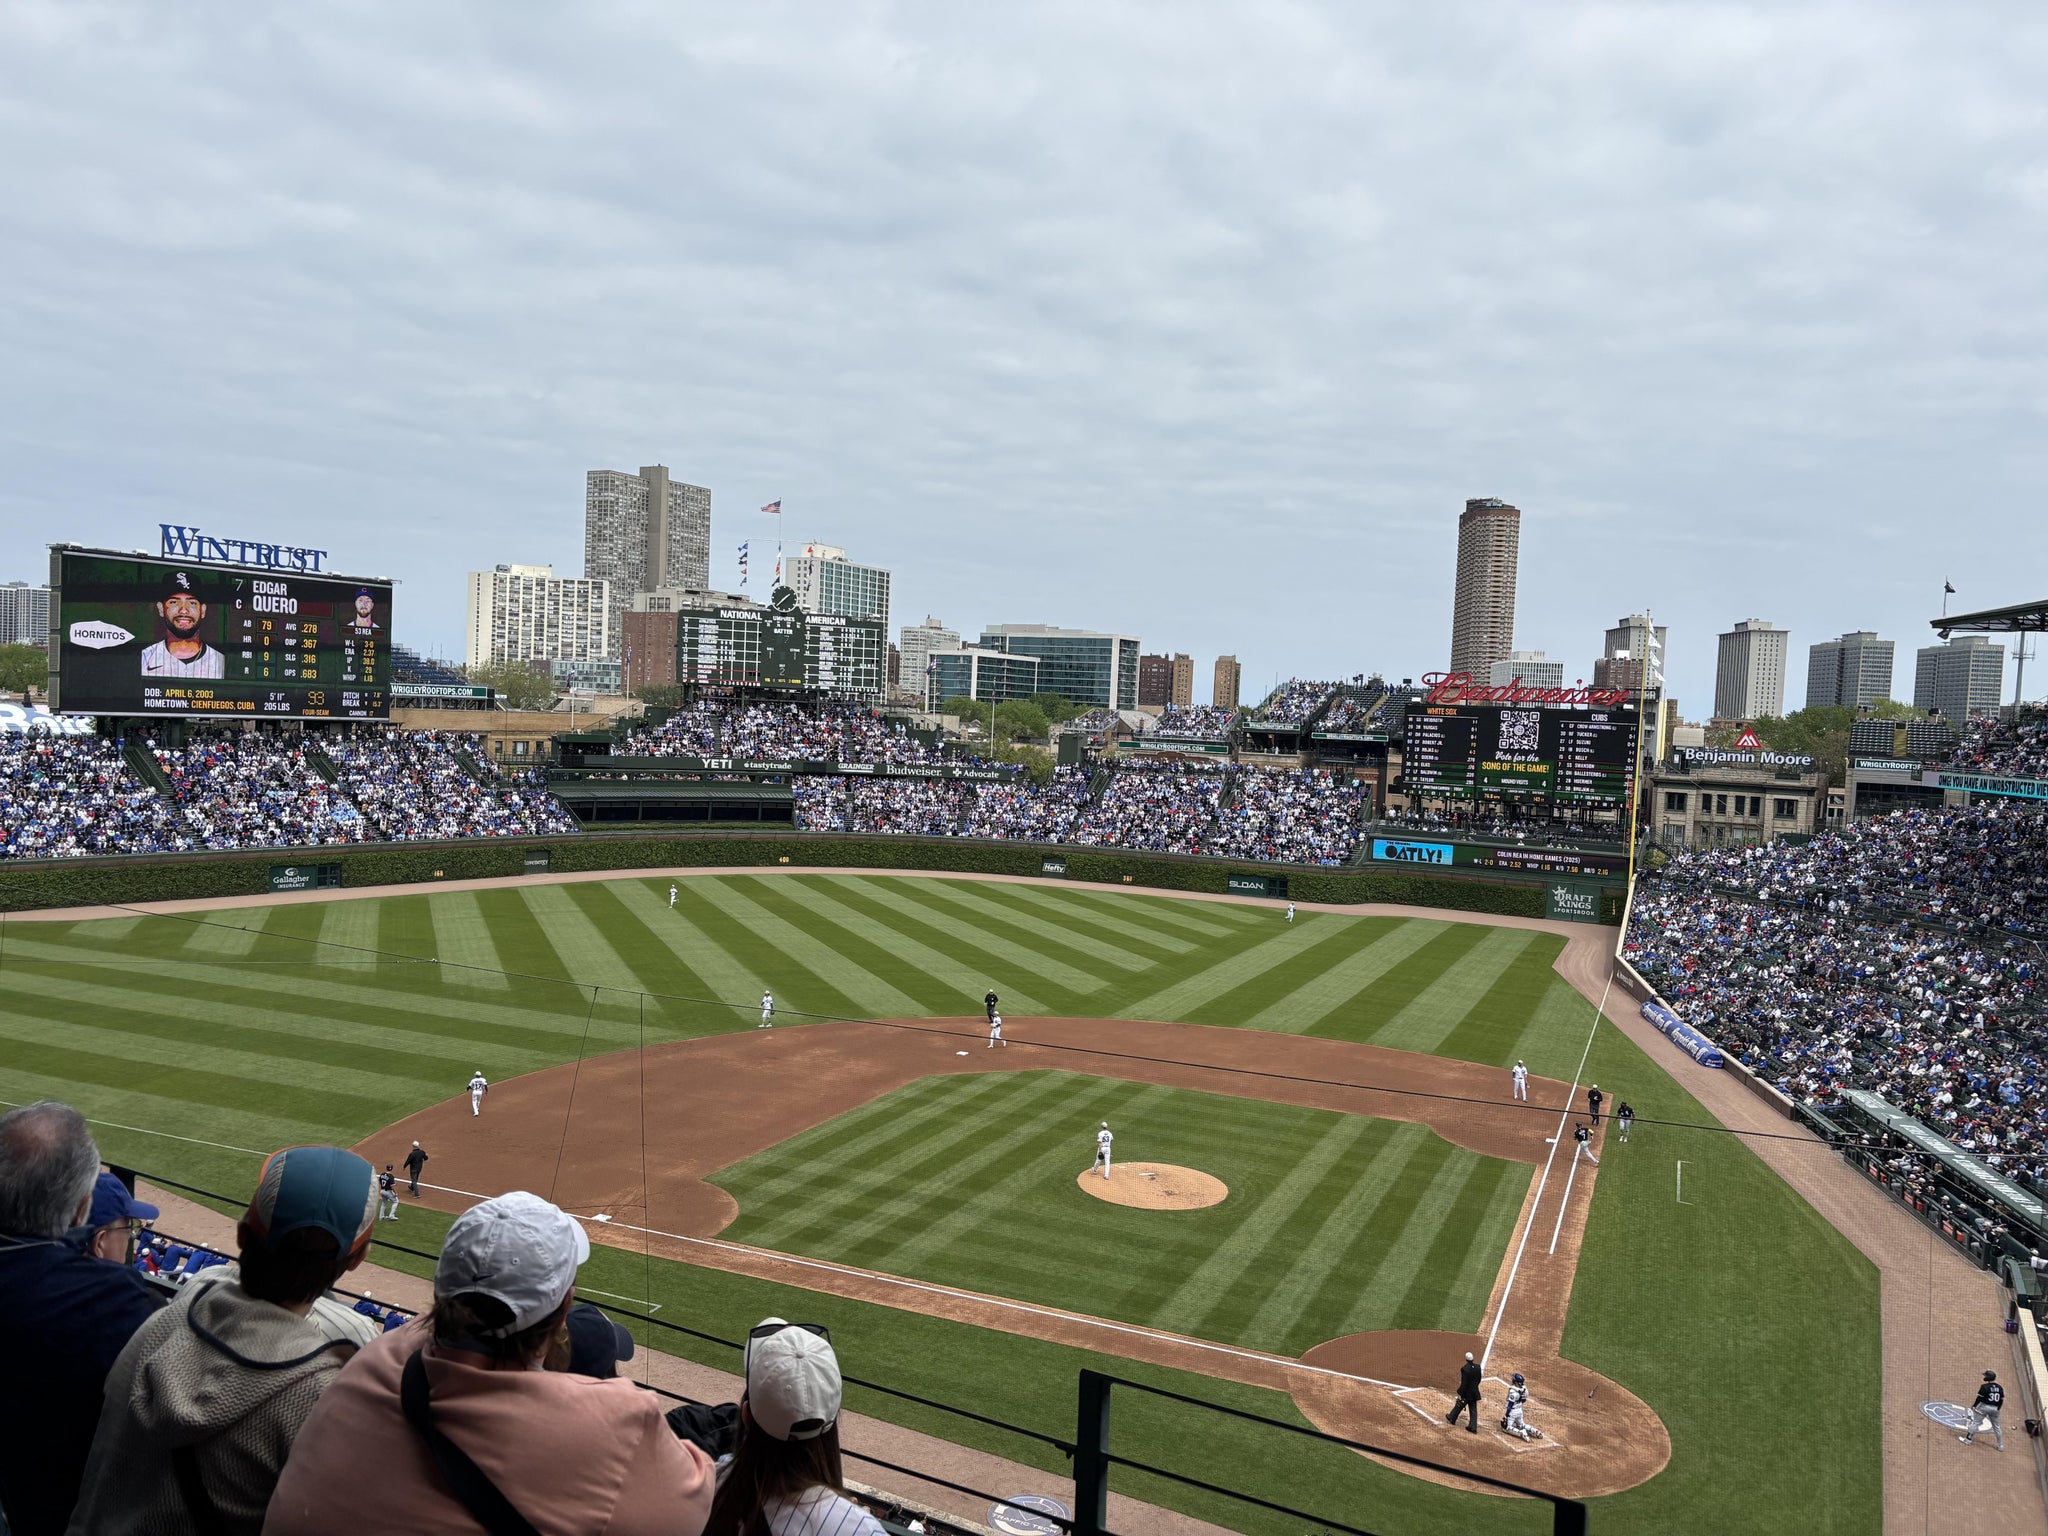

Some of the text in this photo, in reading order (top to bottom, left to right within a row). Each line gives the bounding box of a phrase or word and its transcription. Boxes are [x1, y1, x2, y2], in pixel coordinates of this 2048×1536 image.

[159, 524, 327, 572] WINTRUST
[235, 579, 243, 592] 7
[253, 580, 288, 596] EDGAR
[236, 599, 242, 609] C
[253, 595, 298, 614] QUERO
[720, 610, 762, 620] NATIONAL
[805, 616, 846, 626] AMERICAN
[262, 620, 272, 630] 79
[285, 623, 296, 631] AVG
[301, 624, 318, 634] .278
[74, 630, 126, 641] HORNITOS
[243, 636, 252, 644] HR
[264, 636, 270, 646] 0
[301, 639, 317, 648] .367
[264, 652, 269, 661] 9
[285, 654, 296, 662] SLG
[301, 654, 316, 664] .316
[244, 666, 250, 674] R
[264, 667, 269, 676] 6
[300, 670, 317, 678] .683
[144, 688, 214, 699] DOB: APRIL 6, 2003
[391, 684, 472, 696] WRIGLEYROOFTOPS.COM
[1422, 672, 1630, 706] Budweiser
[308, 691, 325, 706] 93
[343, 692, 360, 700] PITCH
[144, 698, 256, 710] HOMETOWN: CIENFUEGOS, CUBA
[264, 702, 290, 711] 205 LBS
[1592, 714, 1608, 722] CUBS
[1140, 743, 1205, 751] WRIGLEYROOFTOPS.COM
[1495, 750, 1540, 762] Vote for the
[1686, 748, 1810, 765] Benjamin Moore
[702, 759, 732, 769] YETI
[750, 762, 792, 770] tastytrade
[1482, 762, 1500, 770] SONG
[1502, 762, 1511, 770] OF
[1527, 764, 1550, 773] GAME!
[964, 770, 1000, 778] Advocate
[1939, 774, 2048, 797] OMG! YOU HAVE AN UNOBSTRUCTED VIE
[1385, 846, 1442, 863] OATLY!
[1044, 864, 1064, 872] Hefty
[1229, 881, 1264, 889] SLOAN
[1554, 892, 1593, 902] DRAFT
[1558, 900, 1592, 909] KINGS
[1554, 907, 1594, 916] SPORTSBOOK
[1989, 1392, 2000, 1401] 30
[992, 1514, 1057, 1534] TRAFFIC TECH
